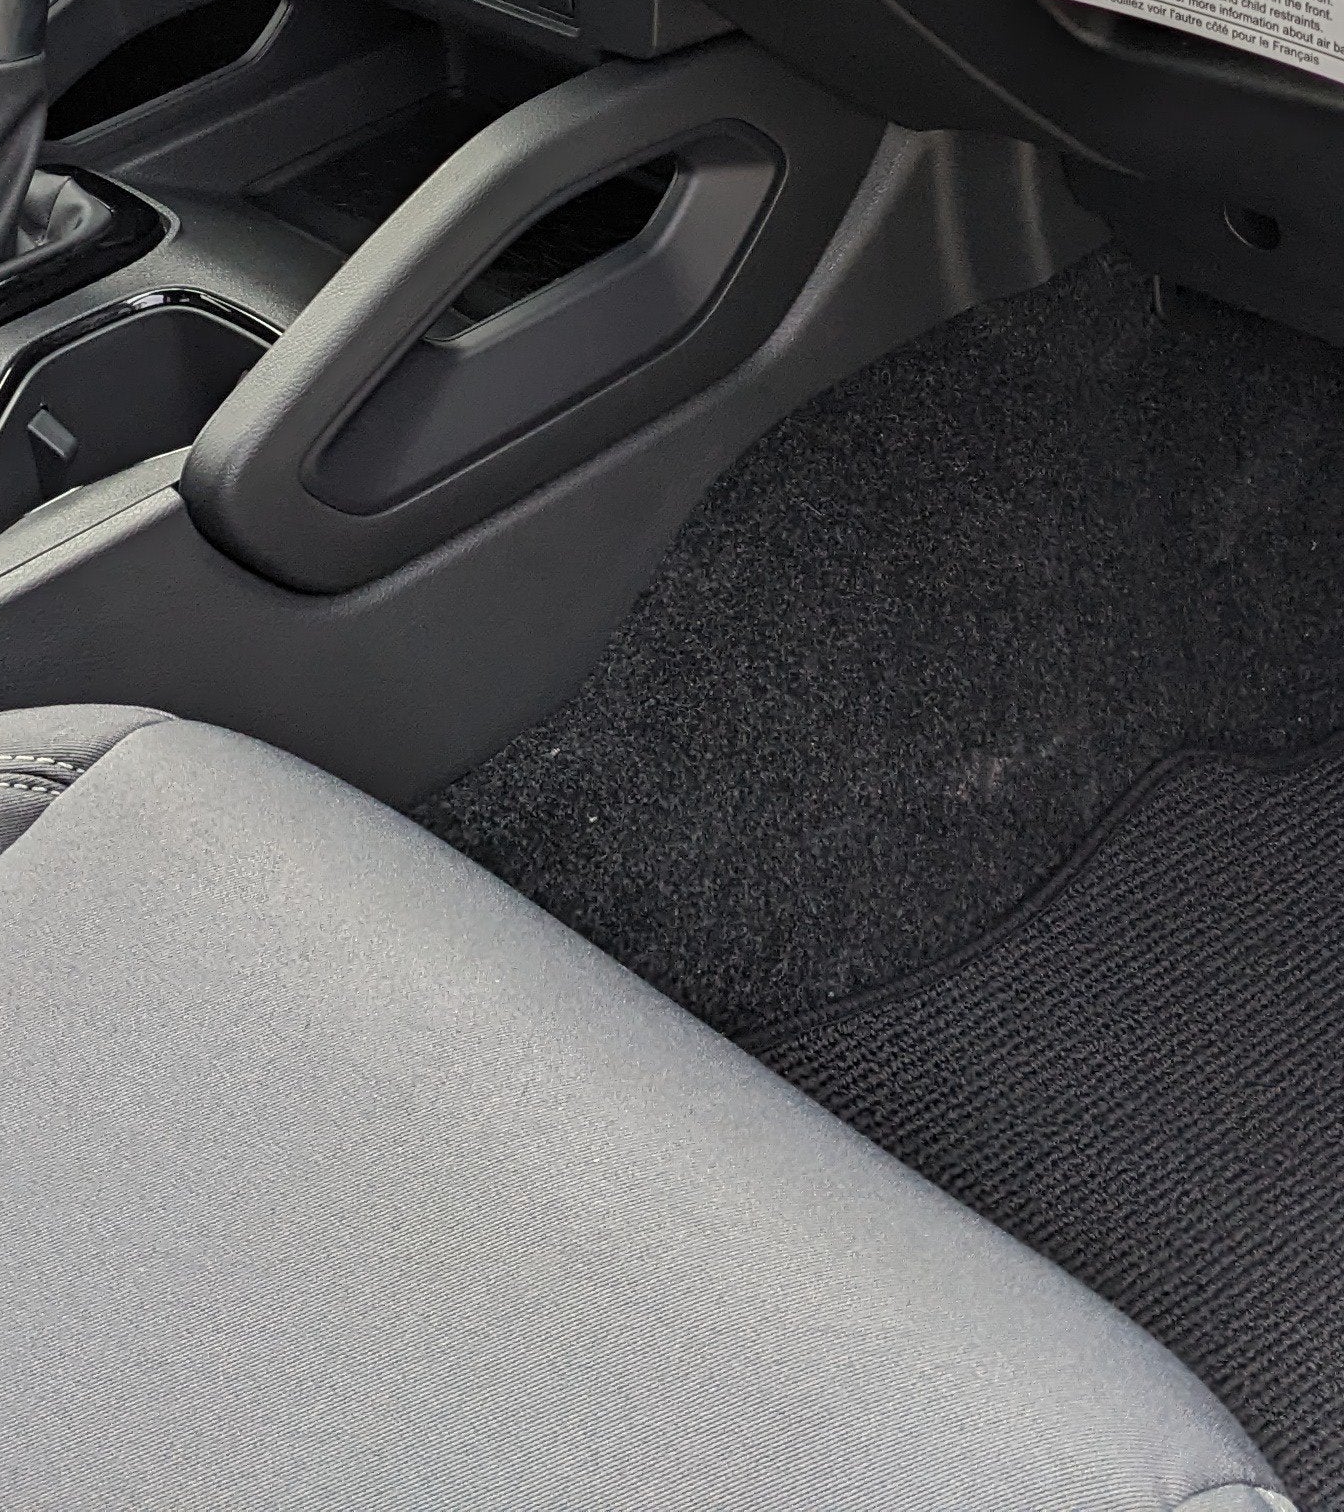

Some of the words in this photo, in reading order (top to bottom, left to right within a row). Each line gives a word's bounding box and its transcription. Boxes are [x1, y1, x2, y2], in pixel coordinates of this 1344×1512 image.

[1147, 4, 1167, 16] voir
[1231, 29, 1257, 44] pour
[1259, 36, 1270, 49] le
[1272, 40, 1320, 66] Français
[1219, 4, 1280, 33] information
[1282, 26, 1314, 45] about
[1316, 38, 1331, 50] air
